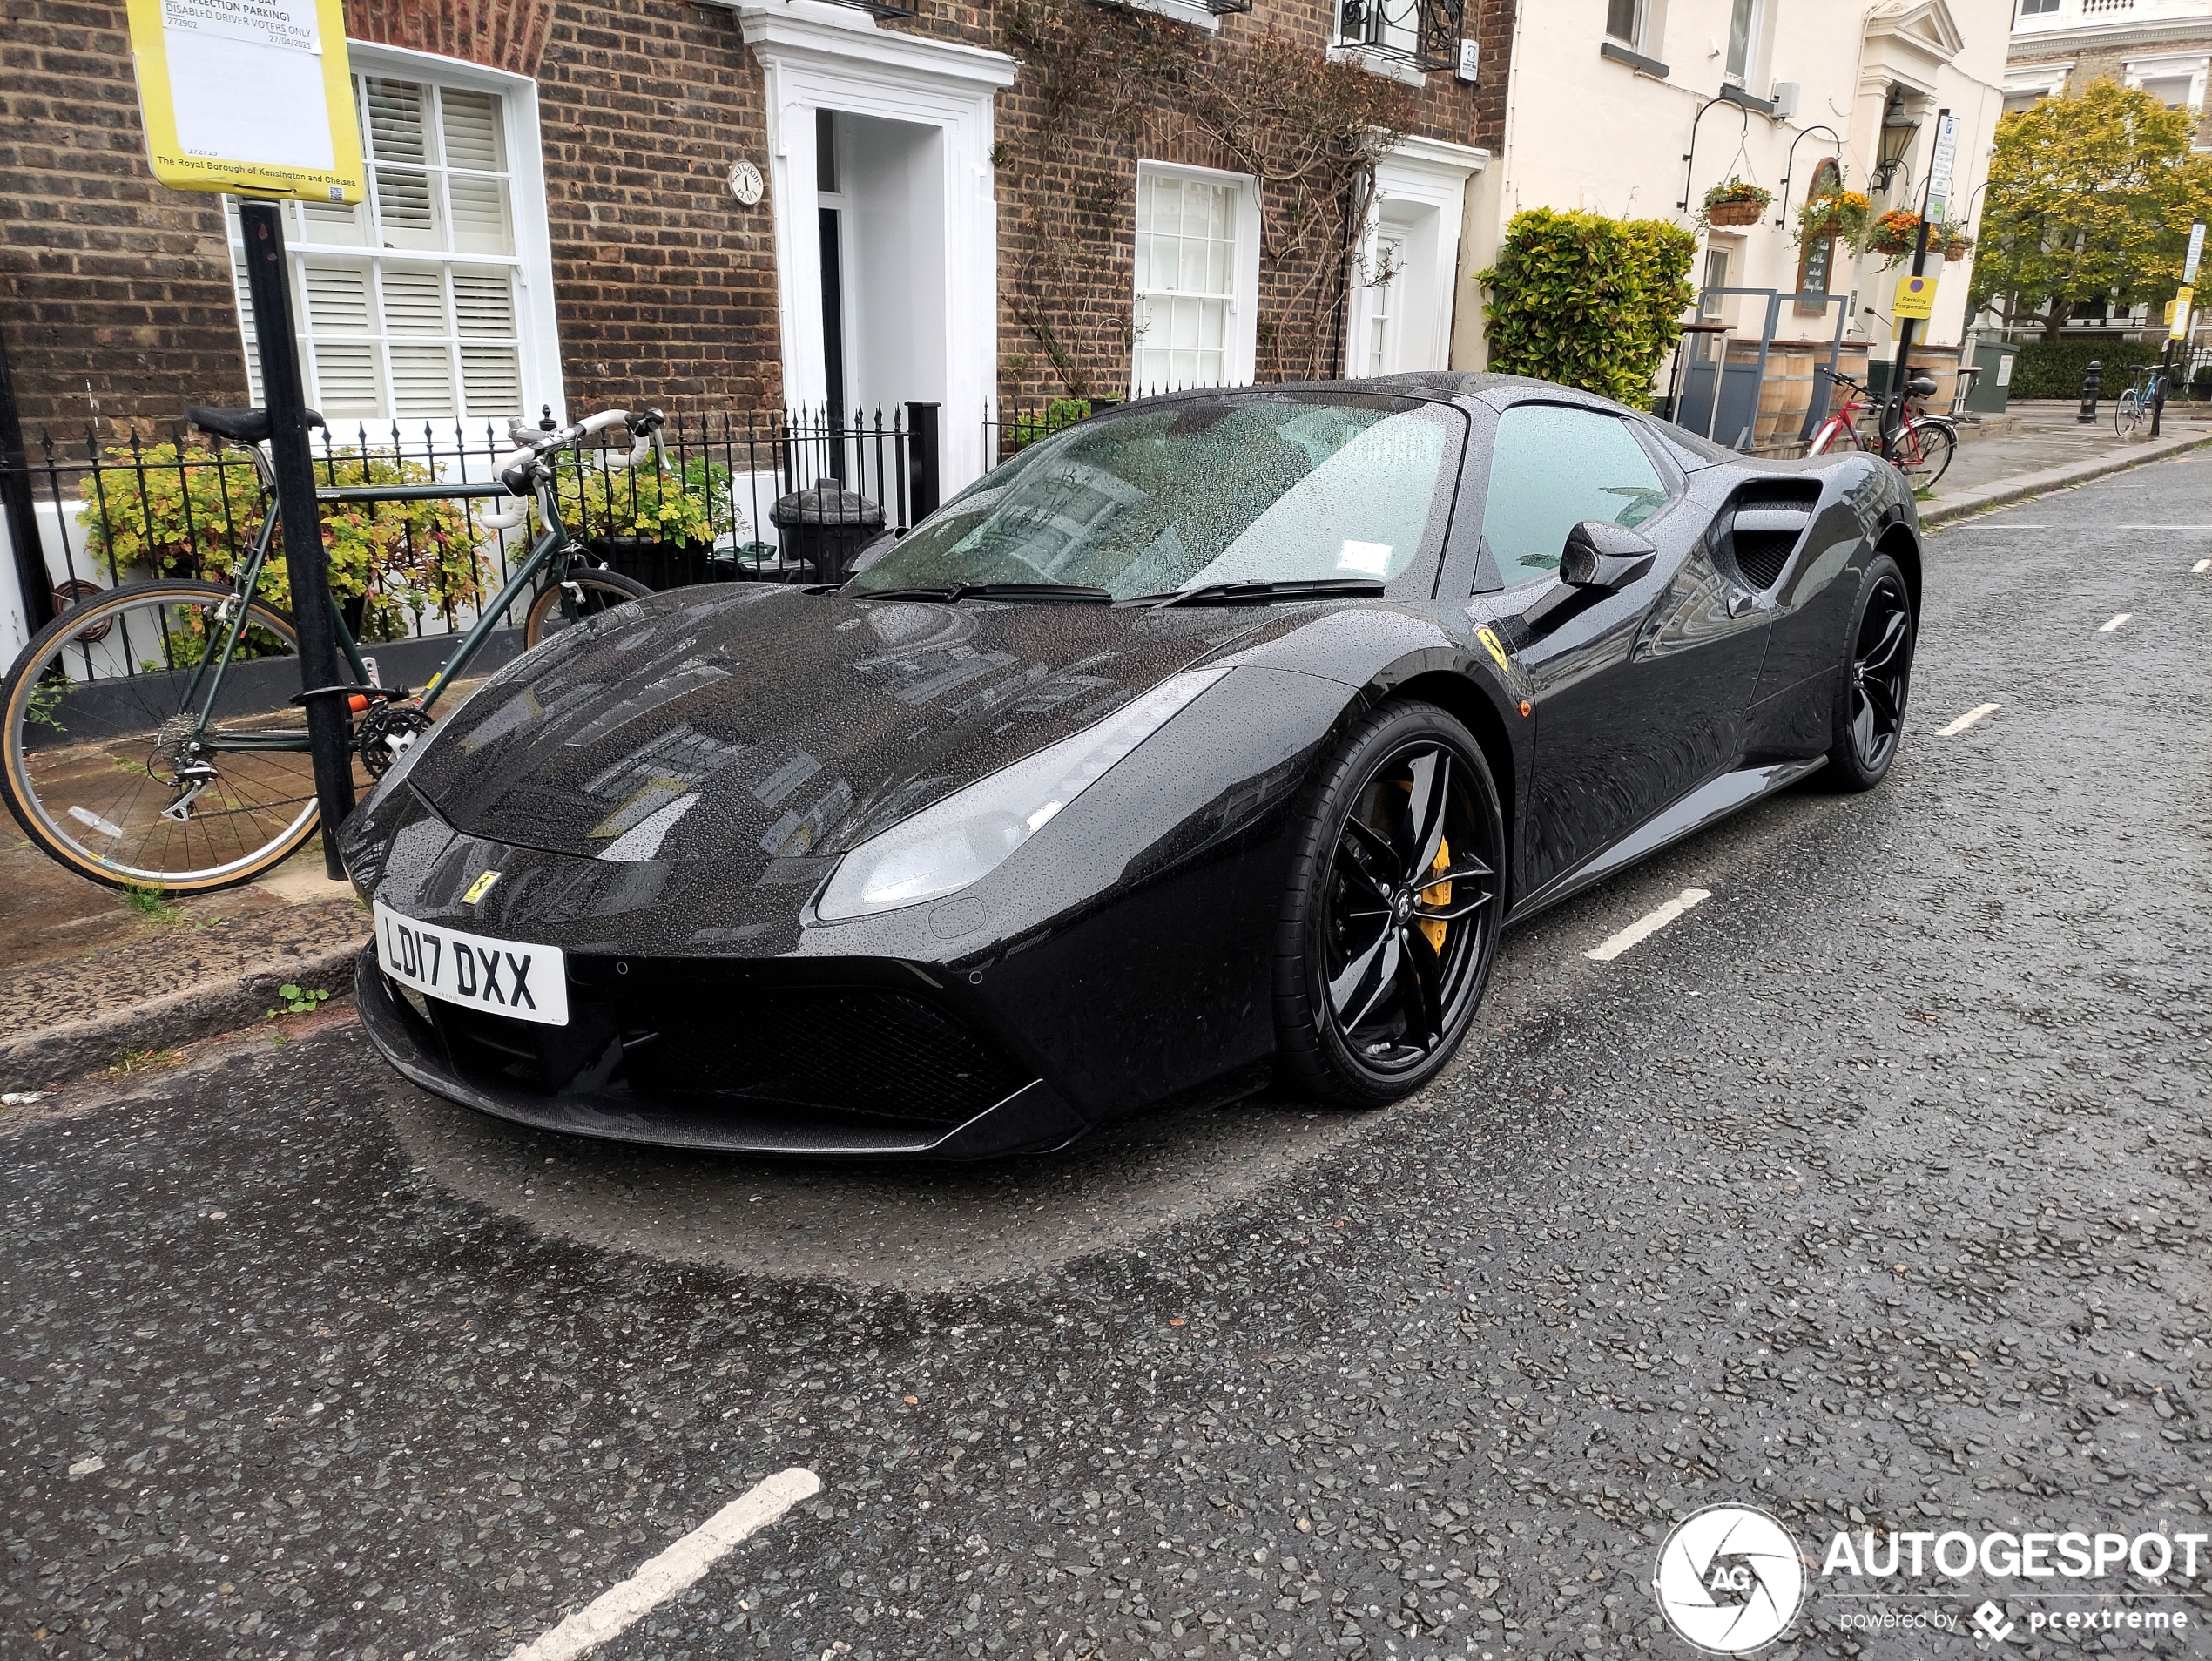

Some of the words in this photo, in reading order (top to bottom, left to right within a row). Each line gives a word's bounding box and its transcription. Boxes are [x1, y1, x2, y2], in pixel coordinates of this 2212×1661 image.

[166, 3, 212, 18] DISABLED
[215, 12, 249, 25] DRIVER
[251, 18, 287, 32] VOTERS
[288, 26, 311, 37] ONLY
[244, 5, 290, 22] PARKING)
[167, 17, 198, 29] 272902
[269, 35, 311, 49] 27/04/2021
[157, 156, 175, 165] The
[178, 158, 204, 169] Royal
[206, 162, 245, 174] Borough
[259, 167, 306, 180] Kensington
[325, 176, 356, 186] Chelsea
[1894, 302, 1932, 311] Suspension
[1902, 296, 1927, 305] Parking
[385, 917, 442, 987] LD17
[452, 941, 536, 1010] DXX
